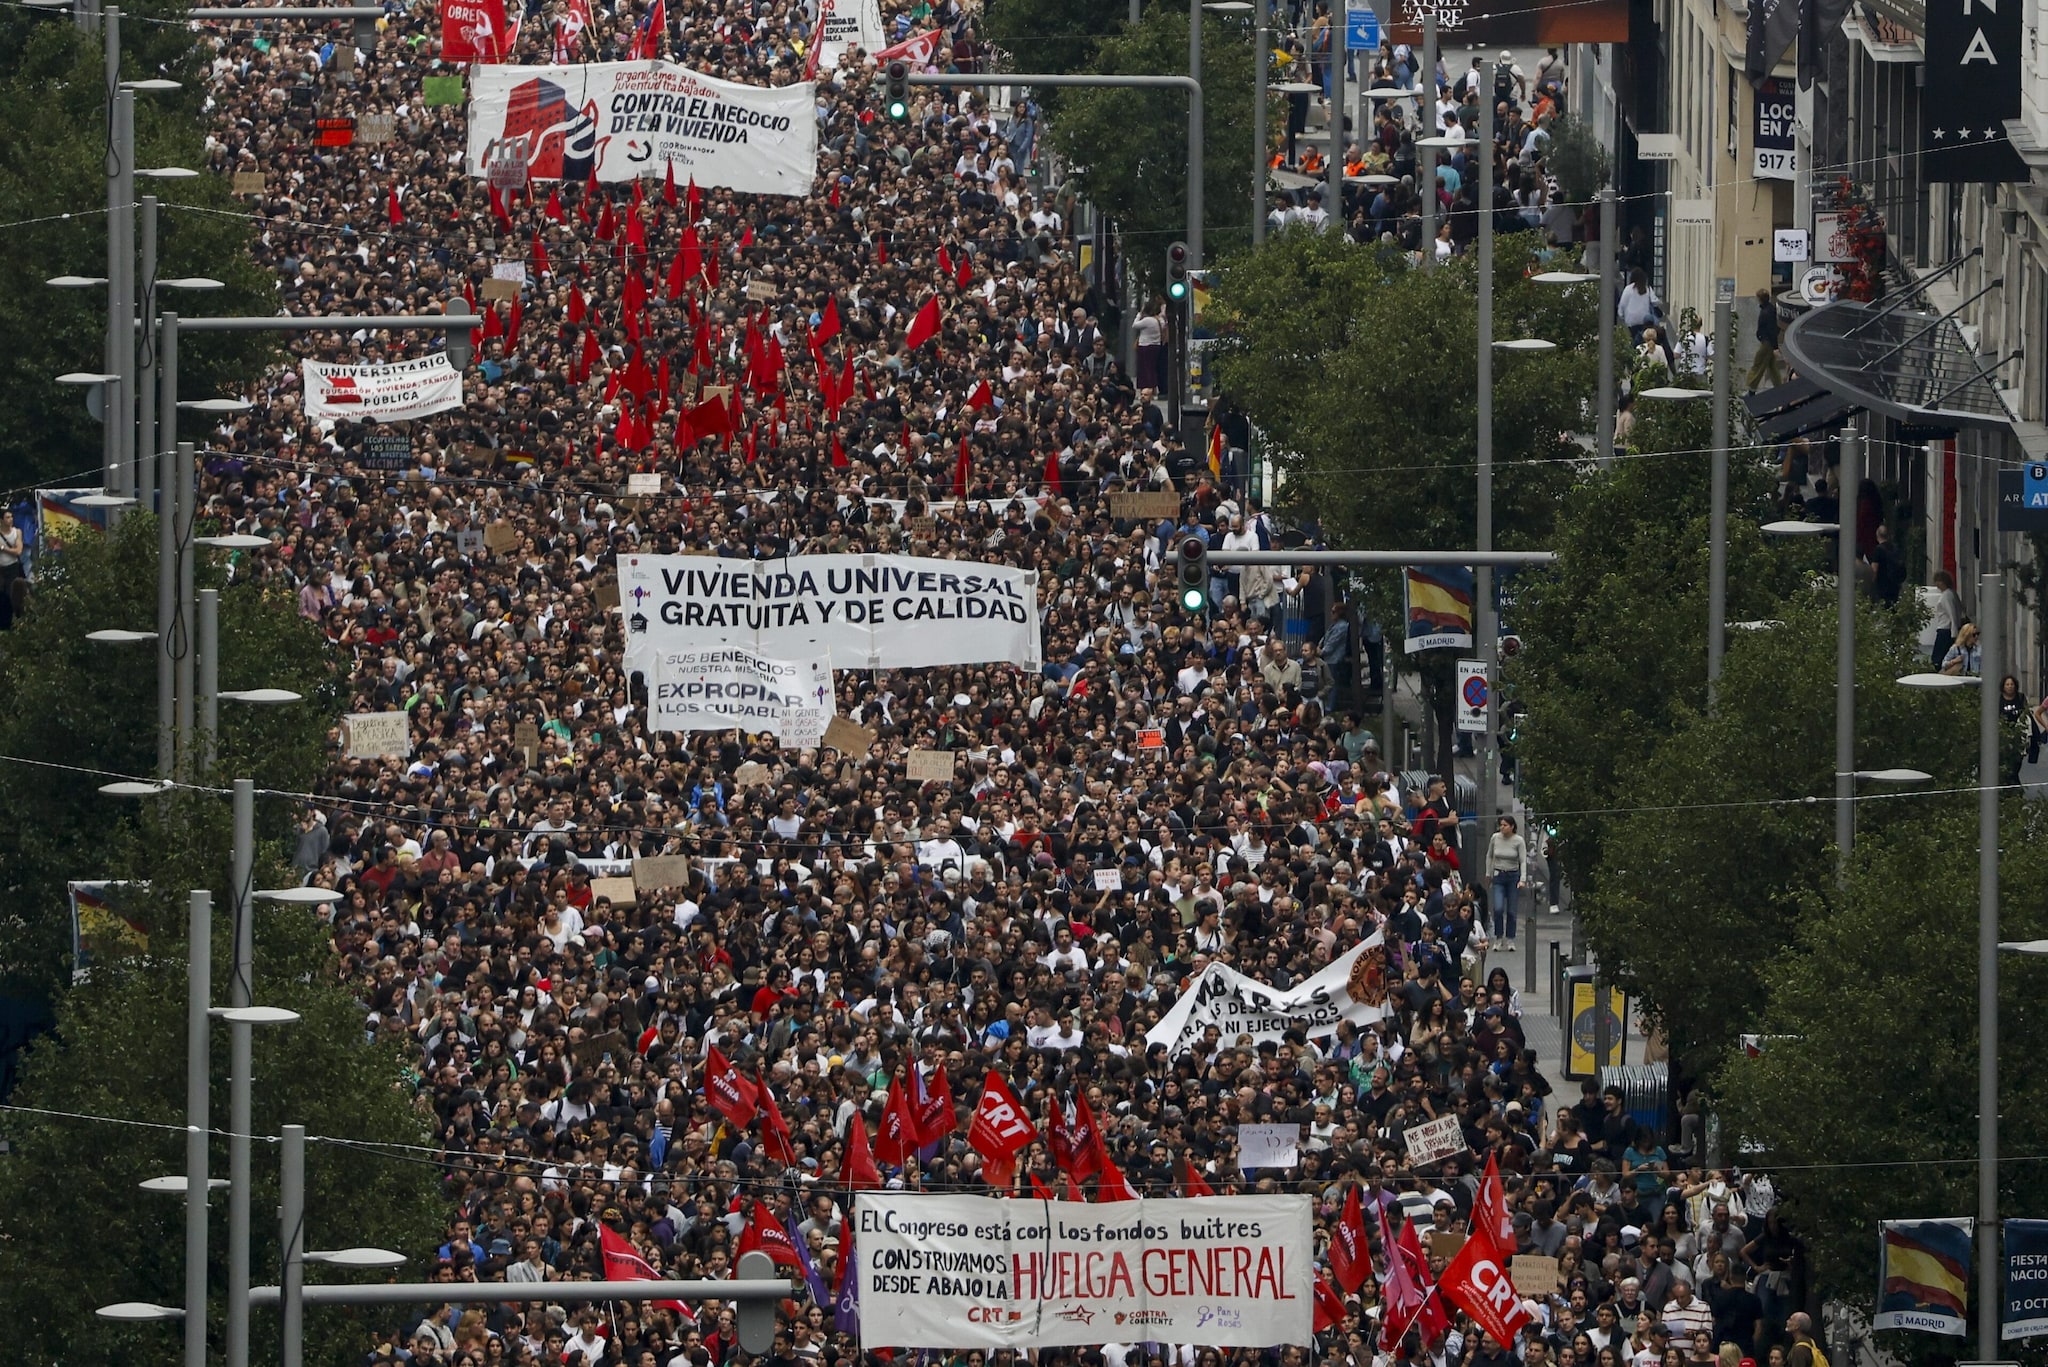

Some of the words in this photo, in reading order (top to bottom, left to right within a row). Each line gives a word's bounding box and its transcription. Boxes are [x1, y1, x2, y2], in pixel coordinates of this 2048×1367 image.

[612, 79, 662, 93] juventud
[611, 93, 686, 117] CONTRA
[688, 98, 709, 120] EL
[712, 102, 790, 132] NEGOCIO
[1760, 102, 1795, 120] LOC
[611, 115, 635, 134] DE
[636, 113, 662, 132] LA
[665, 116, 748, 144] VIVIENDA
[1759, 120, 1782, 137] EN
[1759, 153, 1784, 170] 917
[319, 355, 446, 378] UNIVERSITARIO
[364, 391, 419, 407] PÚBLICA
[2034, 467, 2043, 478] B
[661, 567, 819, 599] VIVIENDA
[828, 566, 1024, 600] UNIVERSAL
[660, 600, 804, 631] GRATUITA
[816, 602, 836, 623] Y
[845, 599, 884, 624] DE
[892, 597, 1028, 625] CALIDAD
[1426, 637, 1455, 647] MADRID
[666, 653, 696, 665] SUS
[700, 651, 797, 676] BENEFICIOS
[678, 664, 732, 674] NUESTRA
[658, 682, 804, 708] EXPROPIAR
[666, 703, 700, 713] LOS
[704, 702, 780, 719] CULPABL
[781, 709, 791, 717] NI
[795, 709, 820, 718] GENTE
[780, 718, 793, 727] SIN
[795, 718, 818, 727] CASAS
[781, 729, 791, 737] NI
[794, 728, 818, 736] CASAS
[780, 738, 793, 746] SIN
[795, 737, 820, 747] GENTE
[1225, 1021, 1241, 1034] NI
[883, 1210, 969, 1242] Congreso
[974, 1219, 1012, 1241] está
[1016, 1224, 1052, 1241] con
[1059, 1219, 1096, 1242] los
[1096, 1218, 1169, 1243] fondos
[1180, 1216, 1263, 1241] buitres
[871, 1248, 1008, 1275] CONSTRUYAMOS
[1012, 1250, 1136, 1301] HUELGA
[1141, 1245, 1296, 1300] GENERAL
[872, 1274, 921, 1295] DESDE
[926, 1275, 983, 1299] ABAJO
[986, 1278, 1008, 1300] LA
[1470, 1259, 1526, 1325] CRT
[966, 1305, 1004, 1323] CRT
[1129, 1310, 1167, 1319] CONTRA
[1217, 1306, 1232, 1316] Pan
[1233, 1309, 1240, 1319] y
[2010, 1300, 2022, 1312] 12
[1129, 1317, 1174, 1327] CORRIENTE
[1905, 1315, 1945, 1330] MADRID
